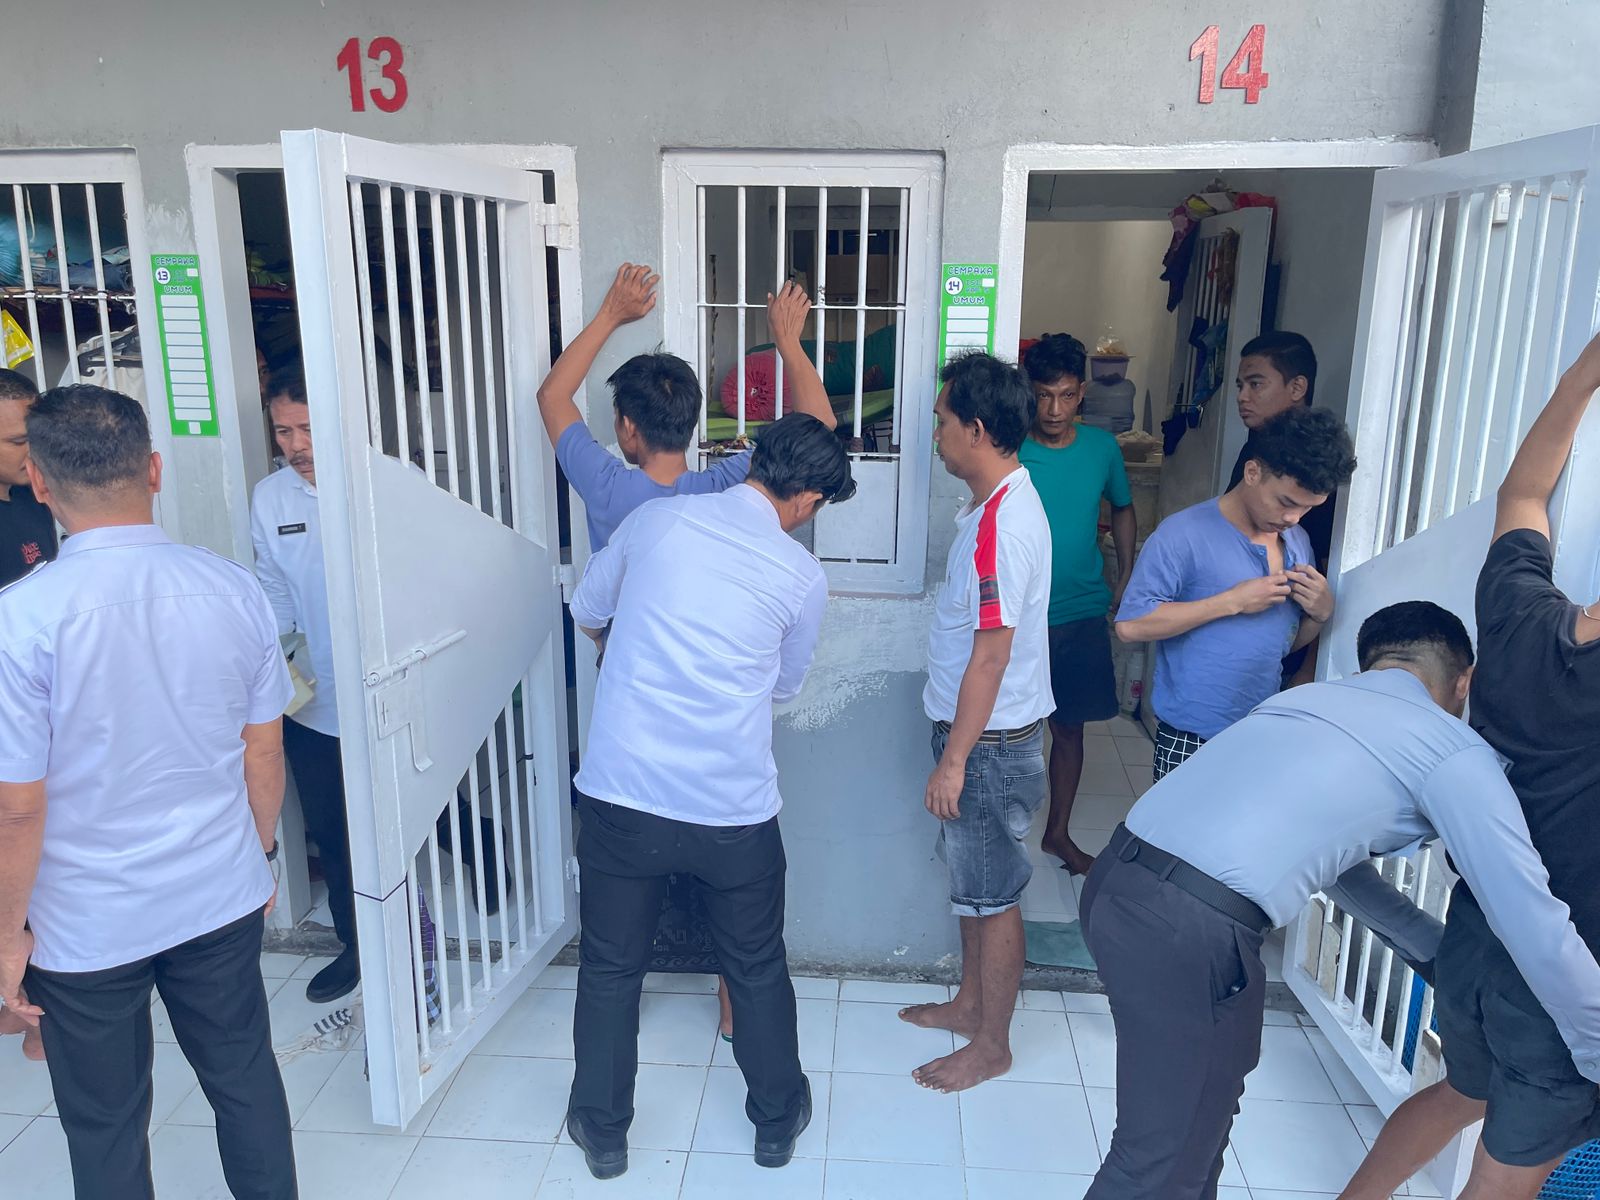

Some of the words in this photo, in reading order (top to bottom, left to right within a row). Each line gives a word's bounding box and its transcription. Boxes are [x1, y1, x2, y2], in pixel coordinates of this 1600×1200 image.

[1189, 24, 1269, 104] 14
[337, 36, 408, 113] 13
[155, 257, 195, 266] CEMPAKA
[948, 266, 993, 275] CEMPAKA
[157, 271, 169, 281] 13
[164, 286, 193, 294] UMUM
[948, 280, 960, 291] 14
[953, 297, 985, 305] UMUM
